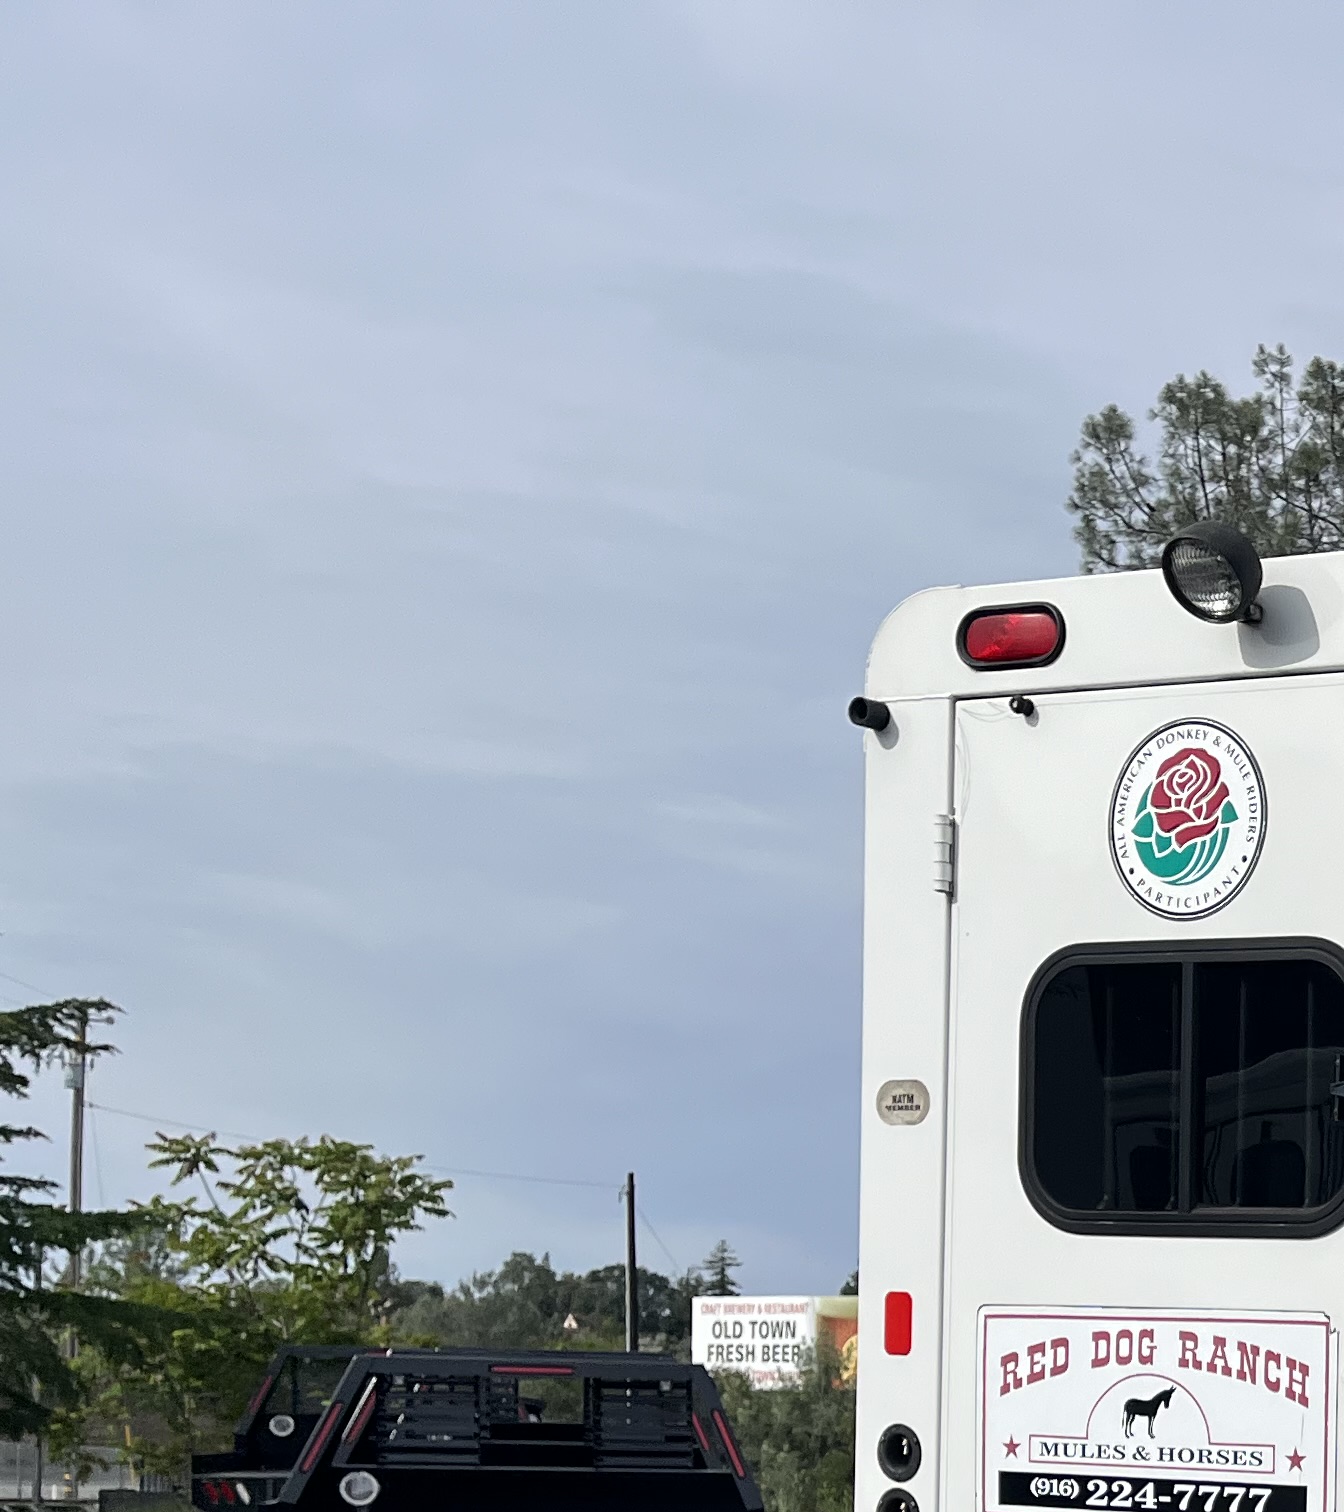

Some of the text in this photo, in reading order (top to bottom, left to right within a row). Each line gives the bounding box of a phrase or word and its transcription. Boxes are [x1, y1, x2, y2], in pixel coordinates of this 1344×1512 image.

[1116, 728, 1258, 859] ALL AMERICAN DONKEY & MULE RIDERS
[1136, 865, 1240, 909] PARTICIPANT
[711, 1320, 797, 1339] OLD TOWN
[707, 1344, 800, 1362] FRESH BEER
[999, 1328, 1310, 1408] RED DOG RANCH
[1038, 1440, 1264, 1467] MULES & HORSES
[1029, 1475, 1080, 1500] (916)
